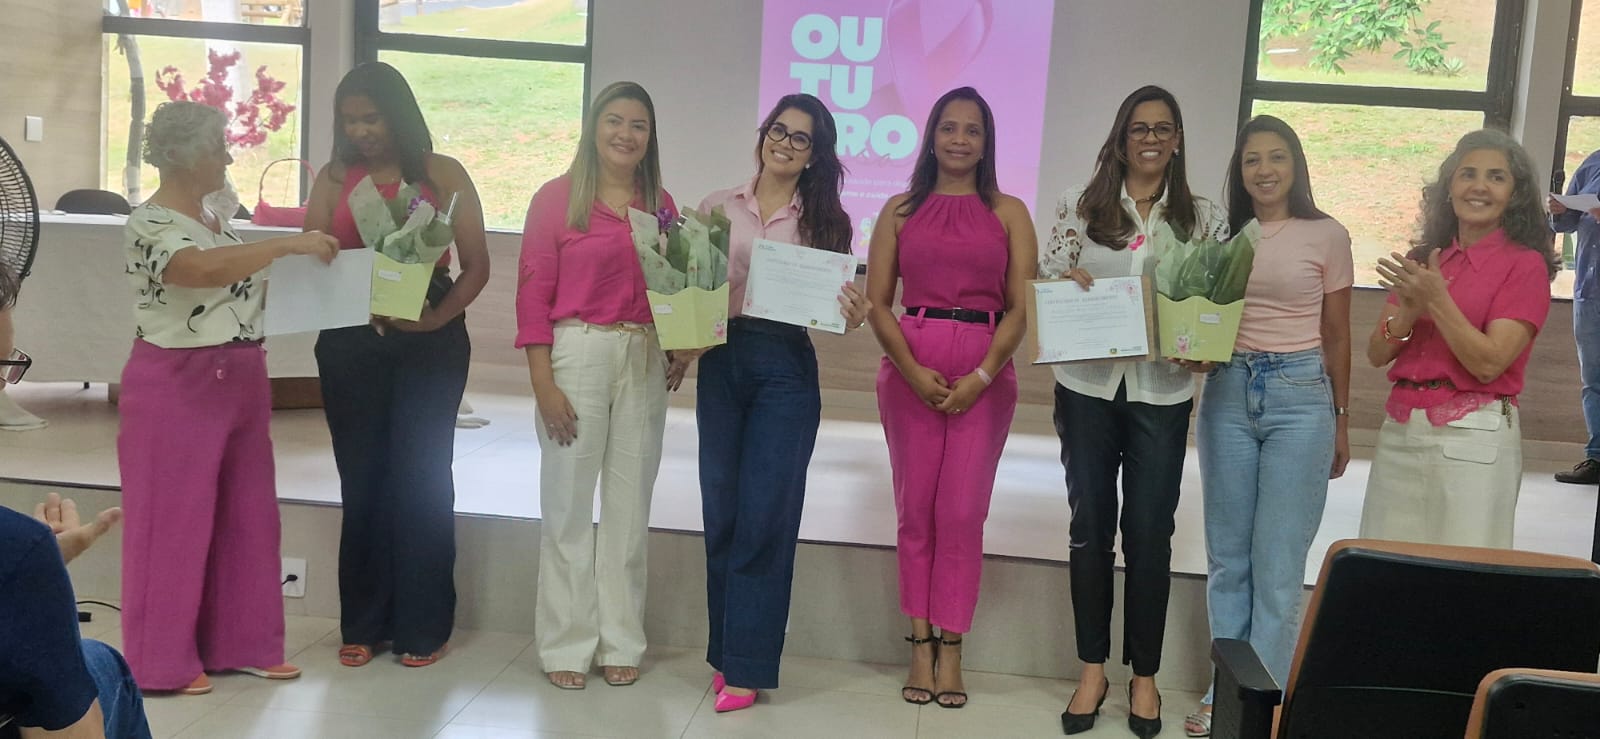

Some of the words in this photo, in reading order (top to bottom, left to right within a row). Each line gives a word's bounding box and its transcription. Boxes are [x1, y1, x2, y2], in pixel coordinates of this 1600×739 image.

[791, 13, 883, 62] OU
[790, 62, 874, 110] TU
[833, 112, 919, 160] RO
